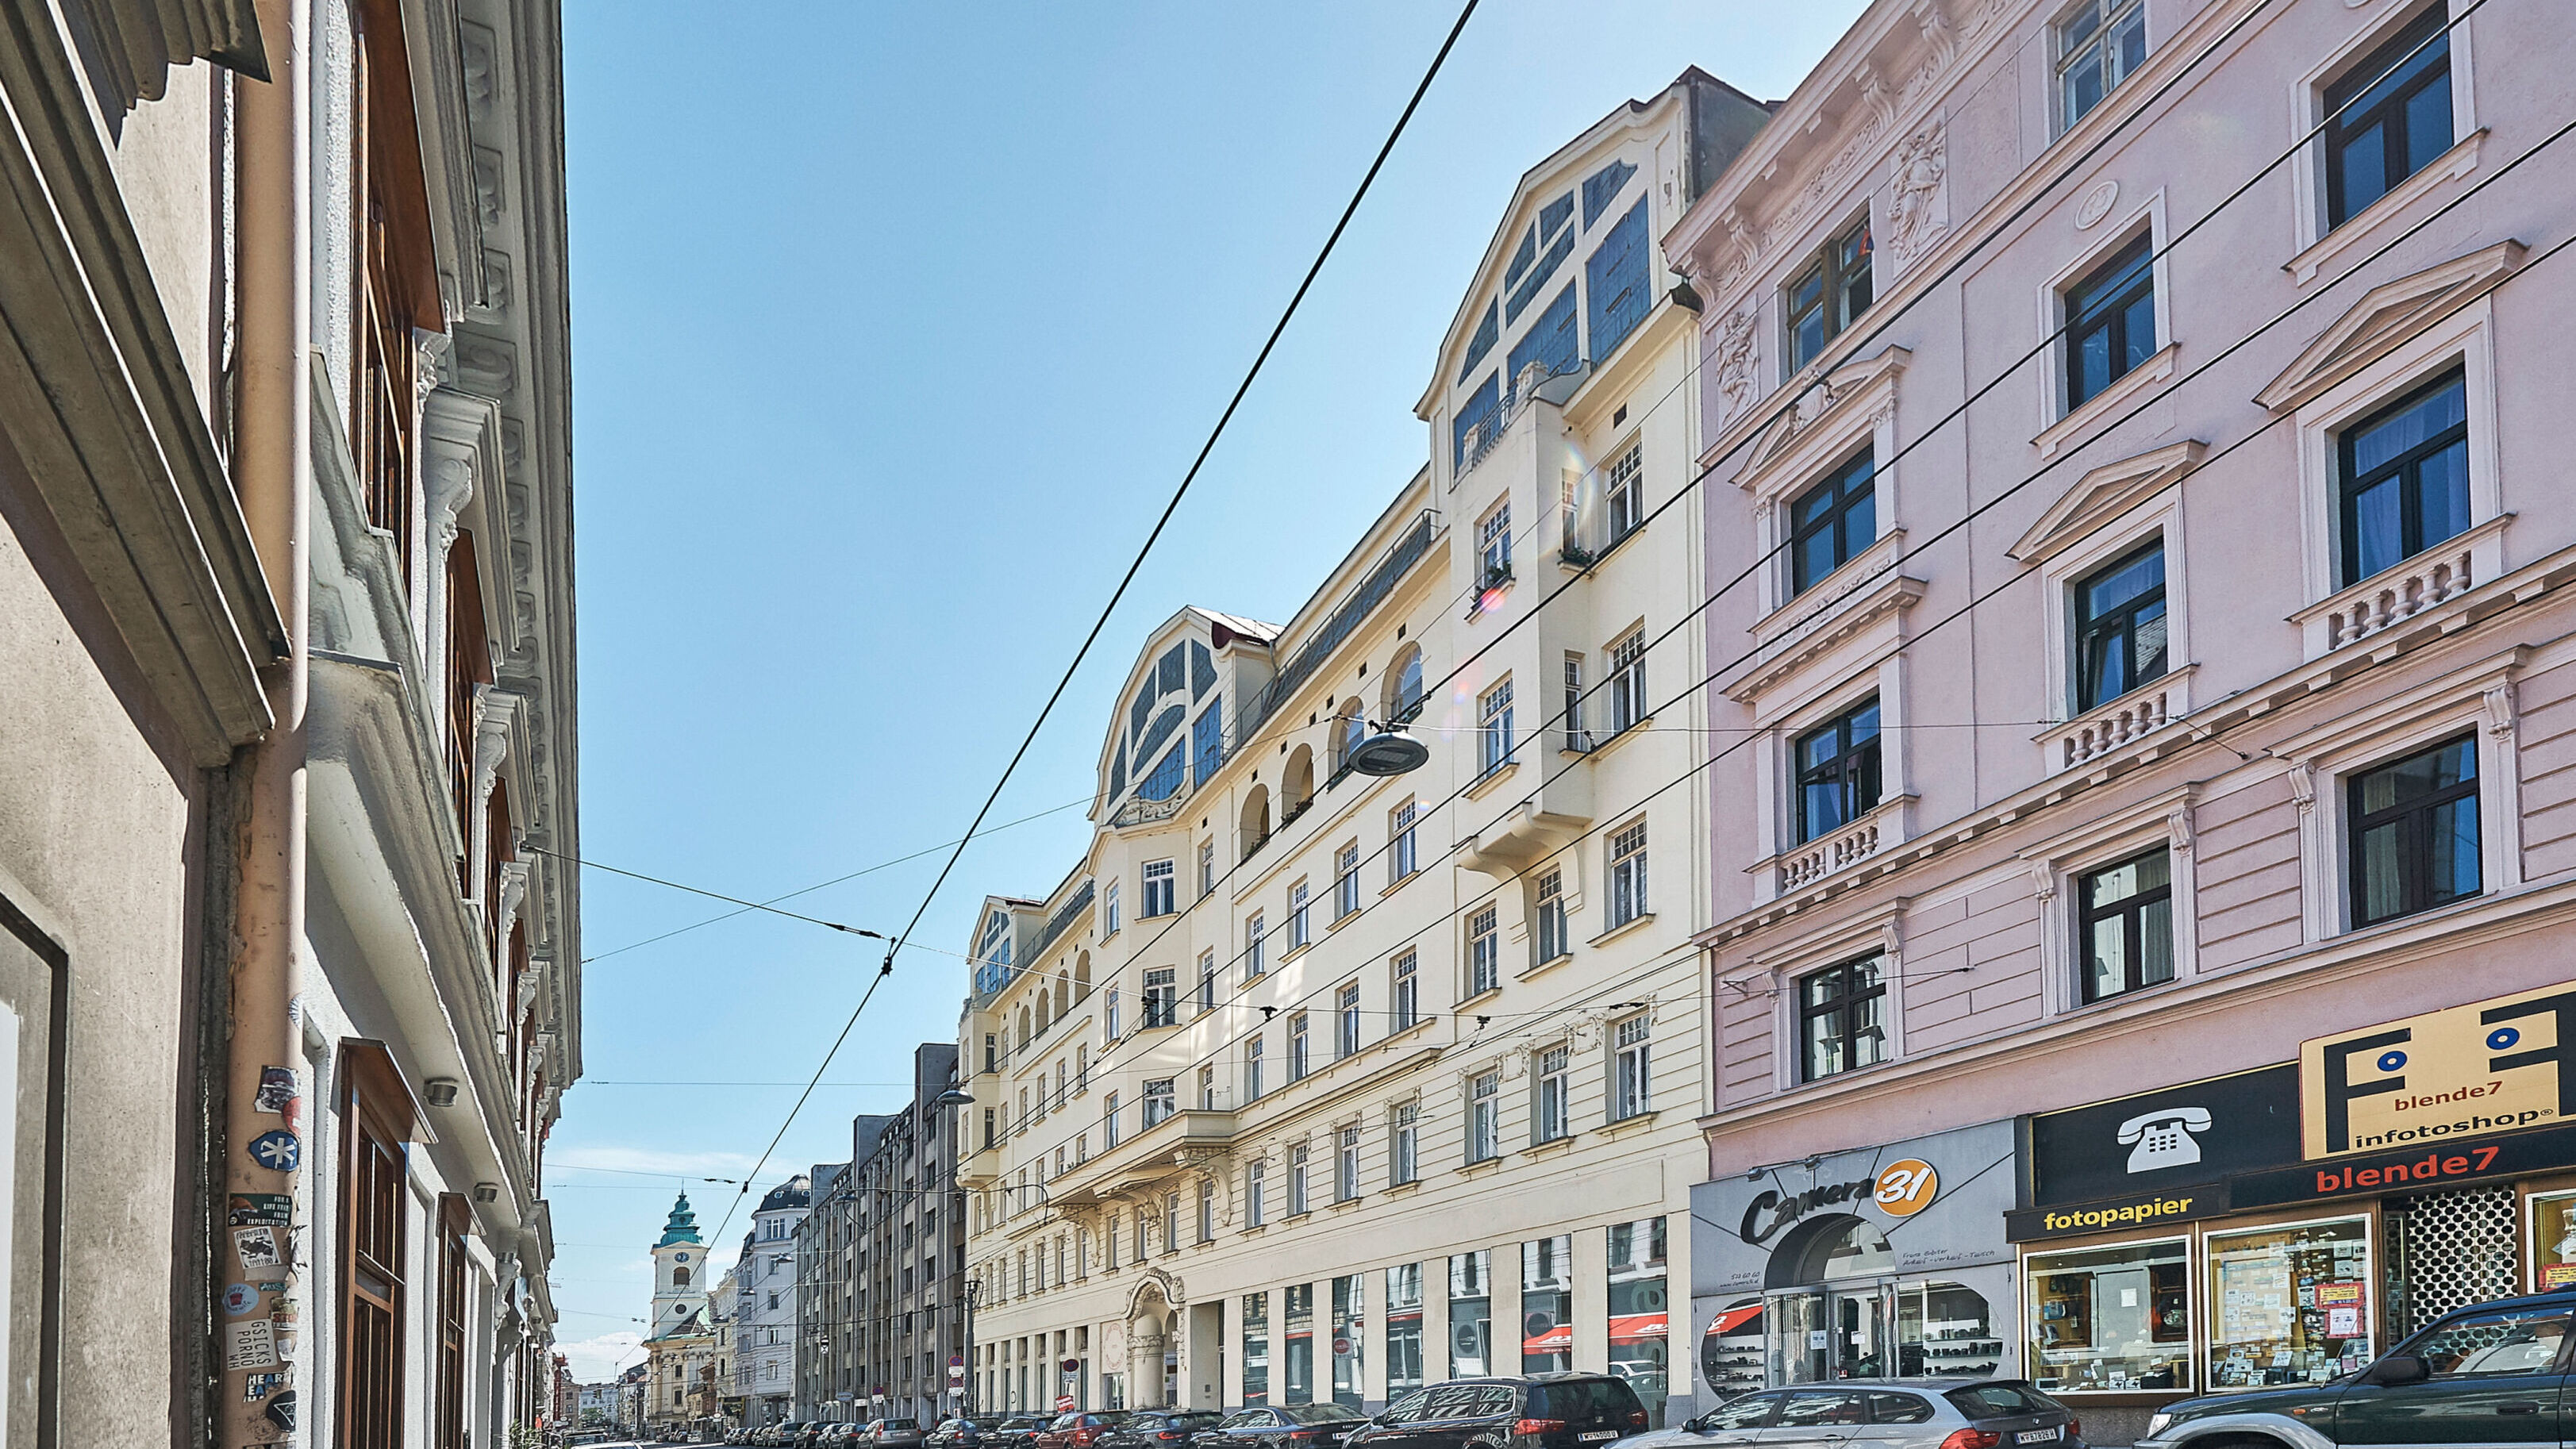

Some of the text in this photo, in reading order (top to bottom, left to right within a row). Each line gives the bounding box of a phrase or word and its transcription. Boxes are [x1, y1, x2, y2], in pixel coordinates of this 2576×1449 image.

[2394, 1080, 2503, 1112] blende7
[2316, 1146, 2499, 1193] blende7
[1740, 1167, 1932, 1244] Camera 31
[2043, 1197, 2193, 1231] fotopapier
[237, 1330, 256, 1366] PORNO
[251, 1320, 271, 1365] GSICKS
